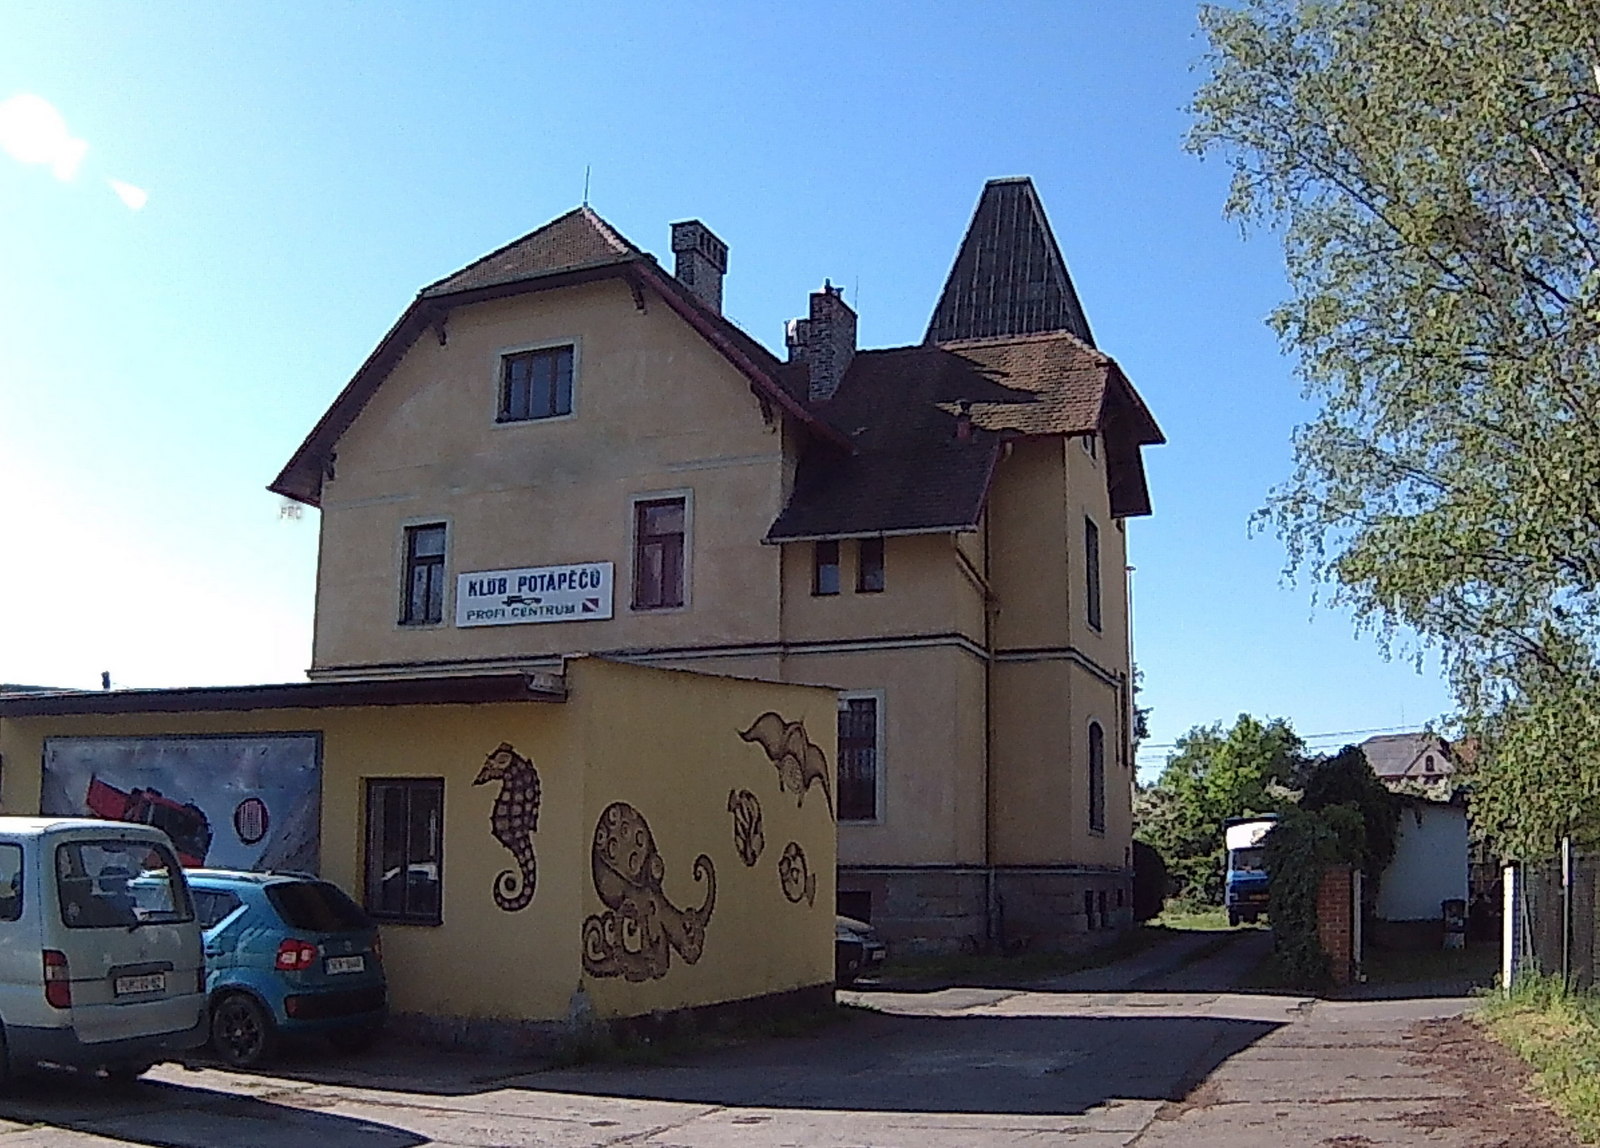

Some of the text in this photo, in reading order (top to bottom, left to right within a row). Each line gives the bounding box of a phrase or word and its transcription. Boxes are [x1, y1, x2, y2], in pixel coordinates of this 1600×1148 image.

[468, 576, 507, 597] KLUB
[466, 604, 576, 621] PROFI CENTRUM
